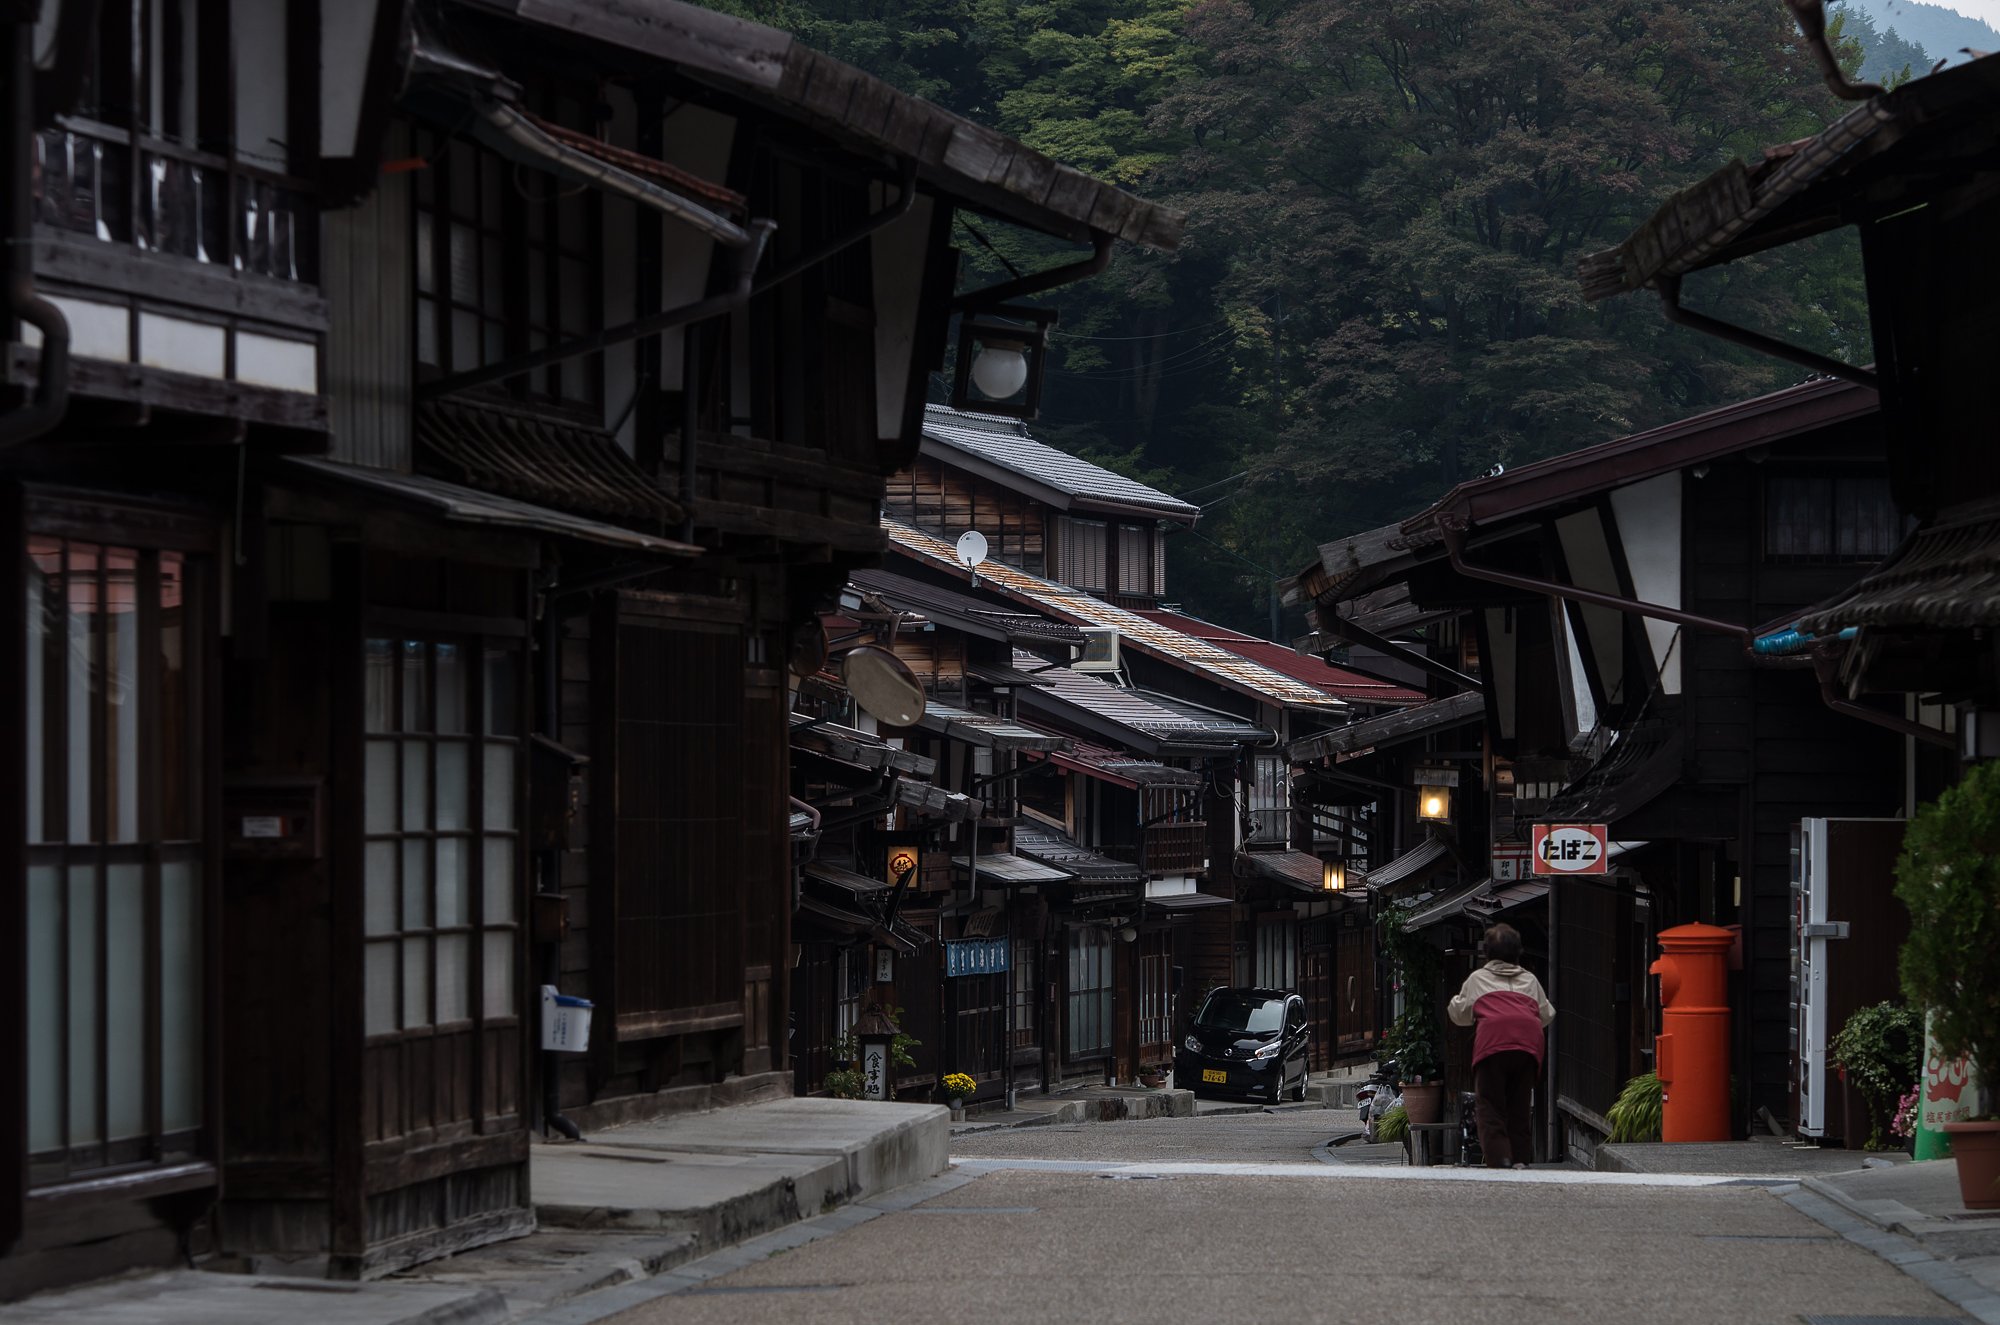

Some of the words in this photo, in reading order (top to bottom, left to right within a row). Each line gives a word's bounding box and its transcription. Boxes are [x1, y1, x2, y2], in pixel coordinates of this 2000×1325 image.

[1542, 839, 1597, 860] たばこ
[865, 1051, 882, 1095] 食事処
